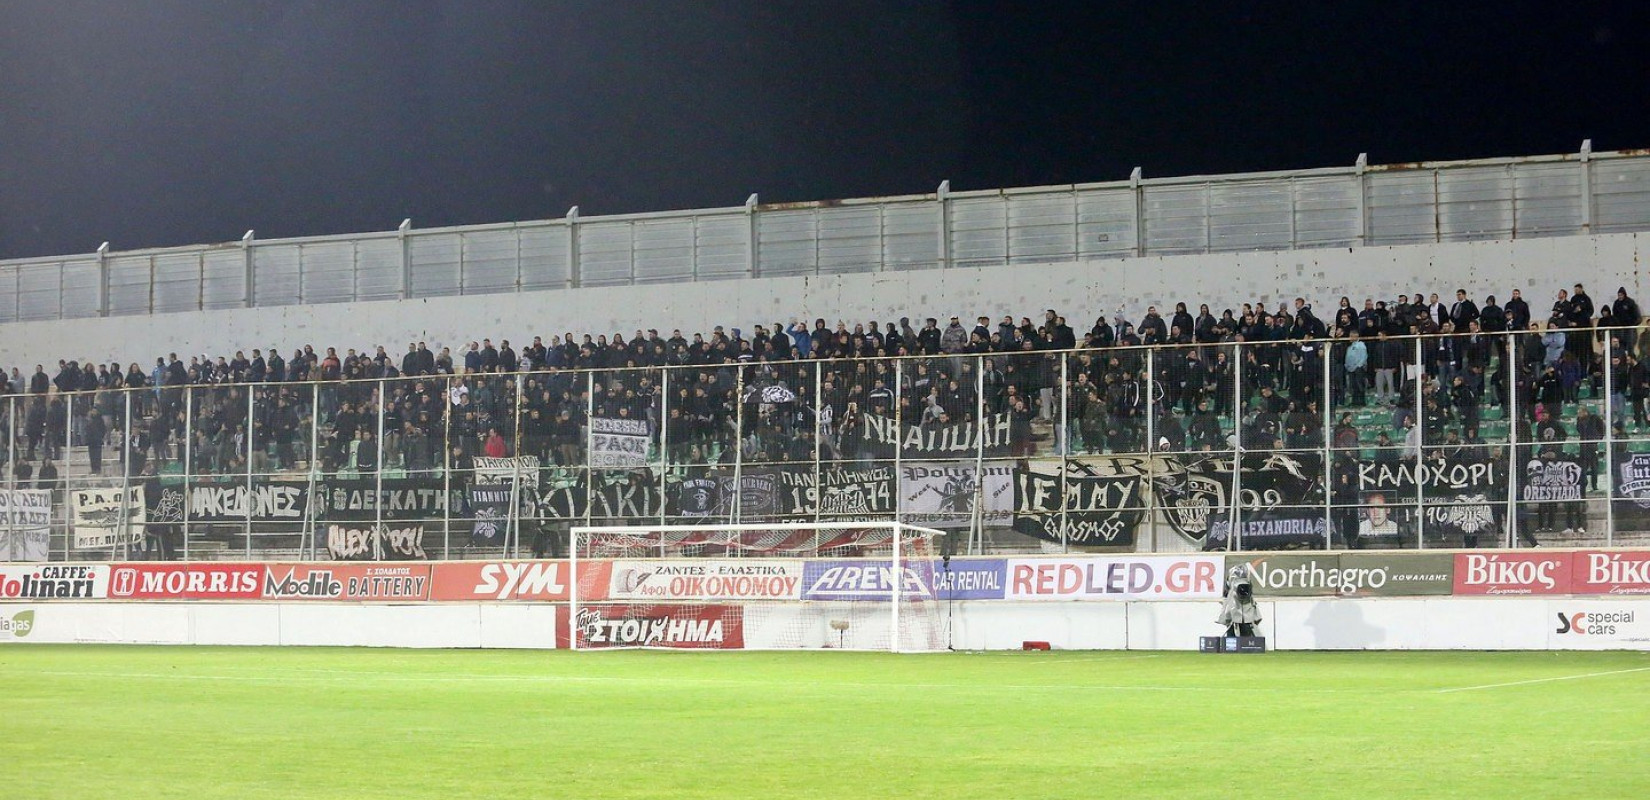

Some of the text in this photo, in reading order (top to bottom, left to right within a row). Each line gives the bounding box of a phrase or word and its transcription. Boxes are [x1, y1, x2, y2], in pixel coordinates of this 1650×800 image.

[1234, 519, 1313, 538] ALEXANDRIA
[140, 570, 258, 594] MORRIS
[264, 566, 343, 599] Modile
[473, 563, 565, 599] SYM
[655, 566, 705, 575] ΖΑΝΤΕΣ
[719, 566, 786, 575] ΕΛΑΣΤΙΚΑ
[806, 567, 932, 595] ARENA
[933, 571, 1000, 590] CAR RENTAL
[1012, 562, 1216, 594] REDLED.GR
[1246, 561, 1386, 593] Northagro
[1464, 554, 1554, 589] Βίκος
[347, 576, 426, 597] BATTERY
[670, 576, 798, 597] ΟΙΚΟΝΟΜΟΥ
[1587, 611, 1634, 624] special
[1587, 624, 1616, 634] cars
[589, 616, 723, 645] ΣΤΟΙΧΗΜΑ
